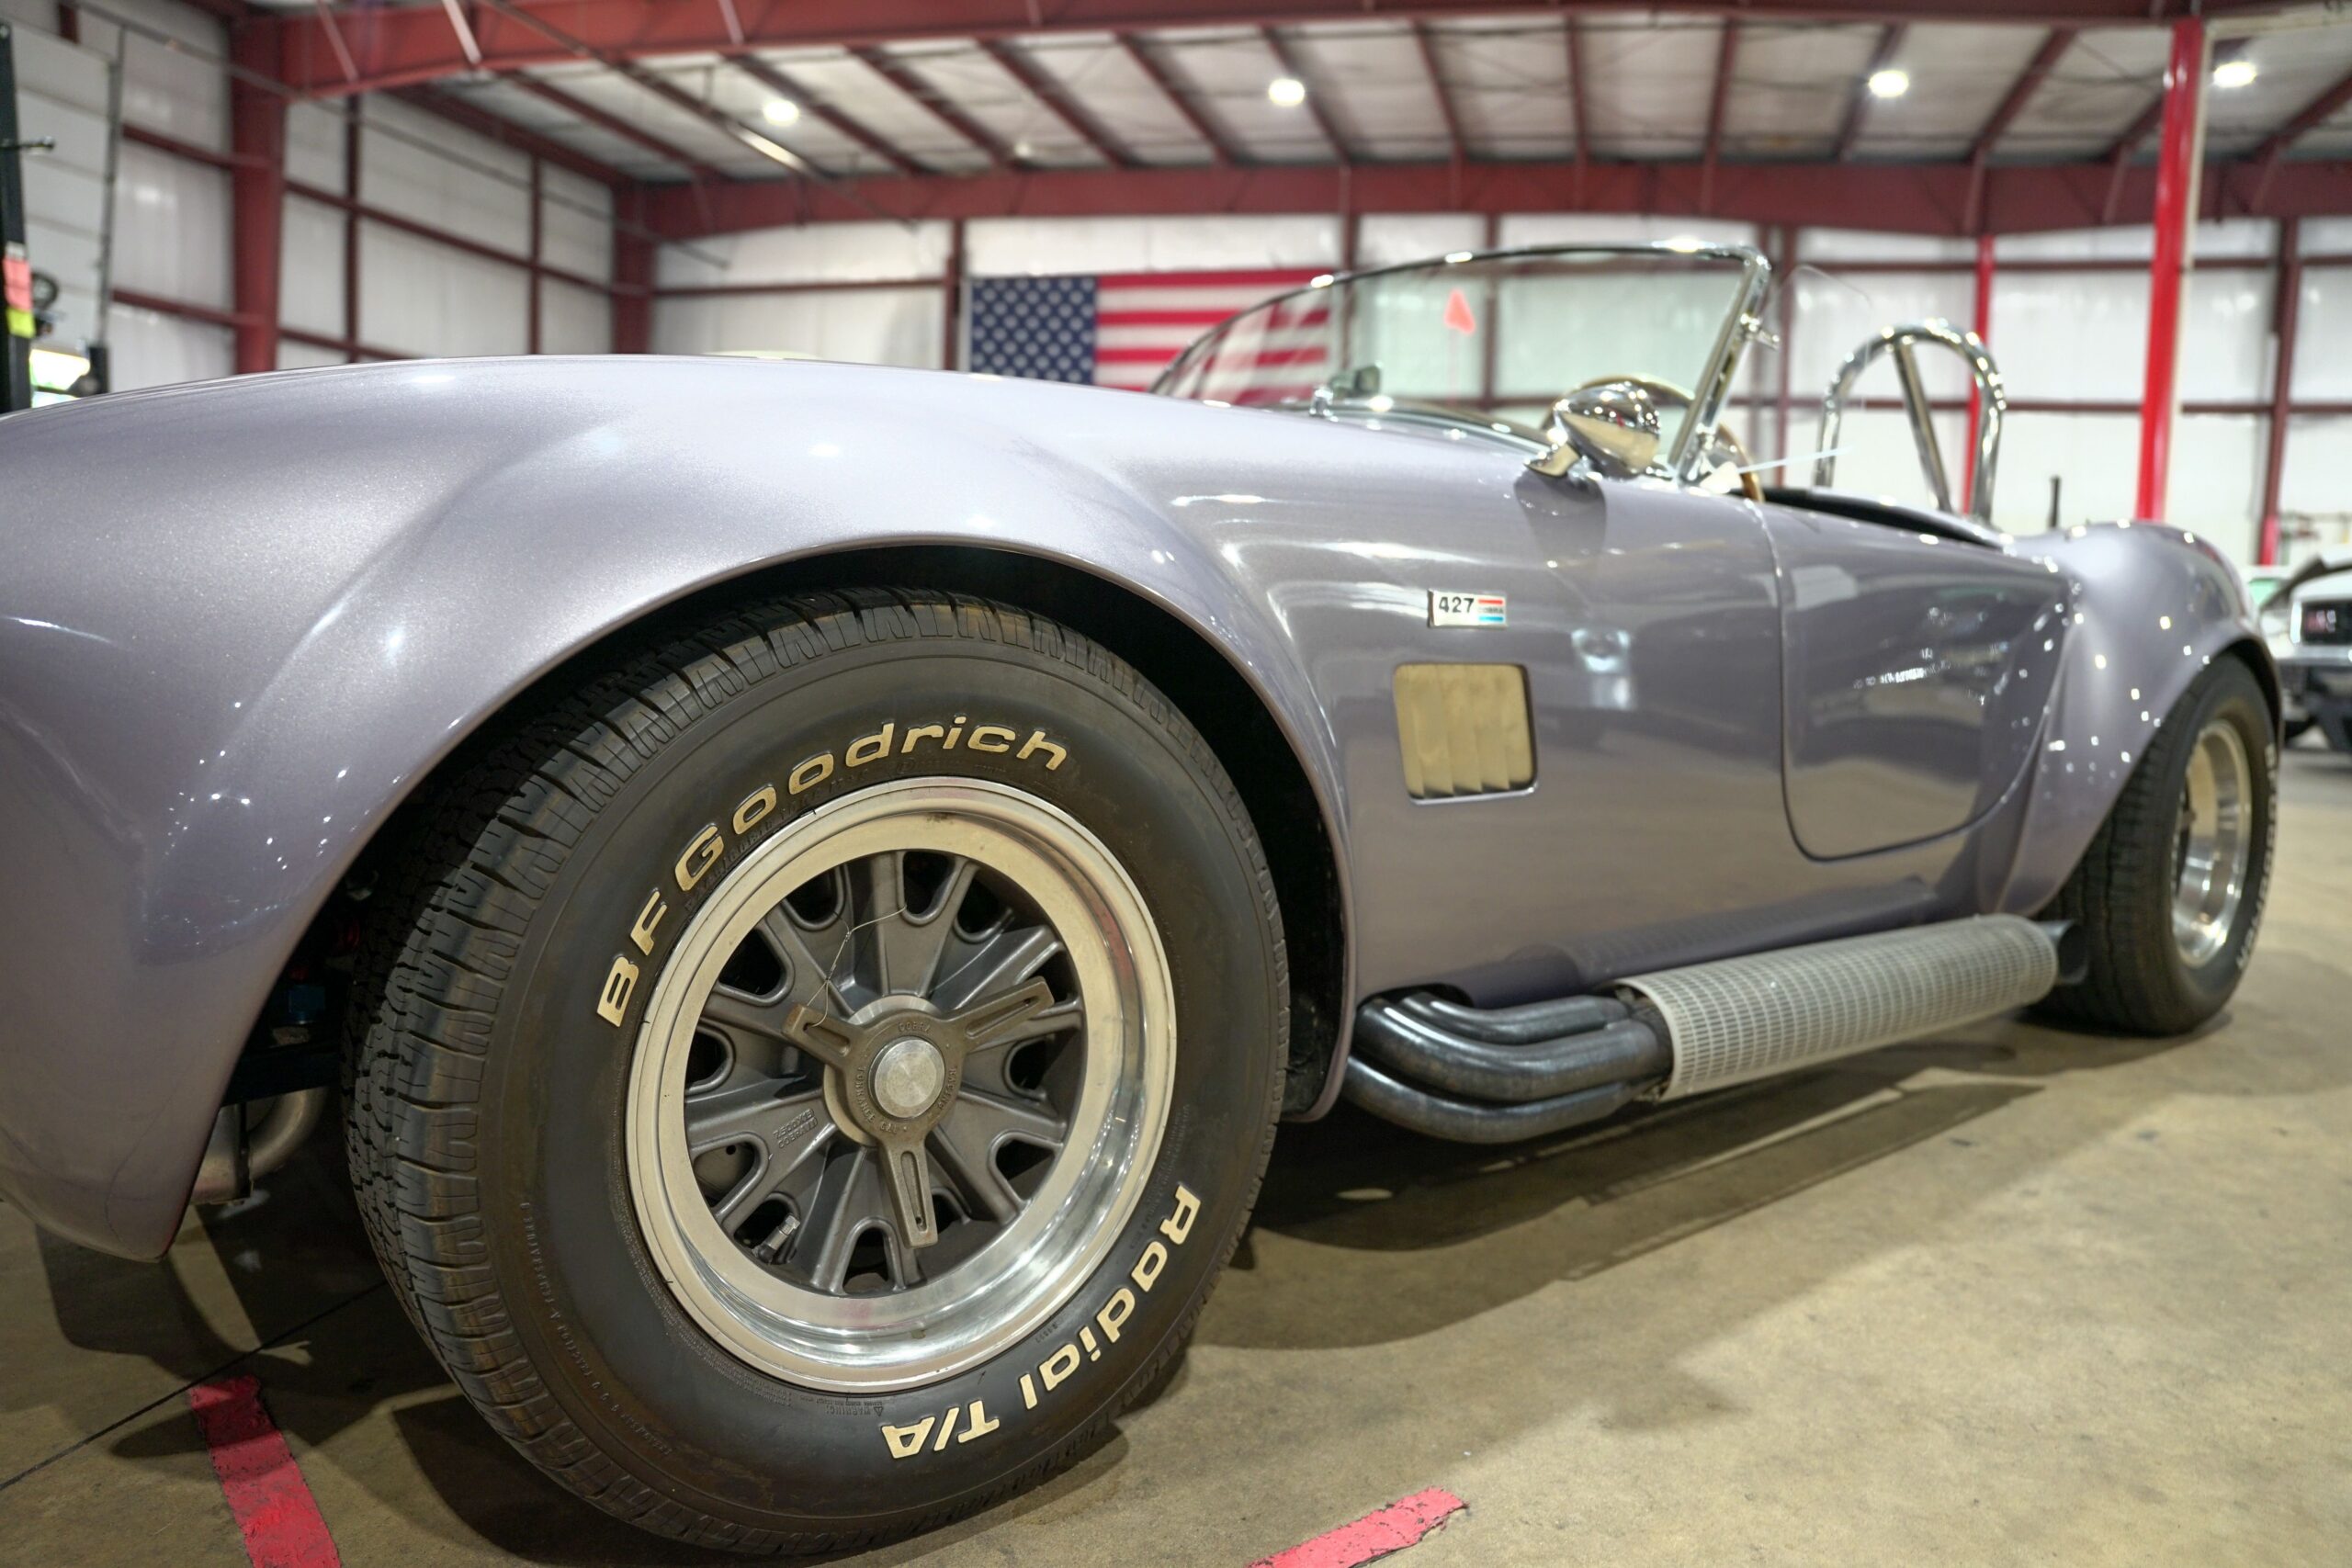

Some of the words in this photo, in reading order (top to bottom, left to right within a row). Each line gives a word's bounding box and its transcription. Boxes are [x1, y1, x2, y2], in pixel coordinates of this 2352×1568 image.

[1438, 596, 1475, 614] 427
[596, 715, 1069, 1028] BFGoodrich
[898, 1021, 932, 1033] COBRA
[1019, 1184, 1202, 1411] Radial
[881, 1399, 1001, 1460] T/A
